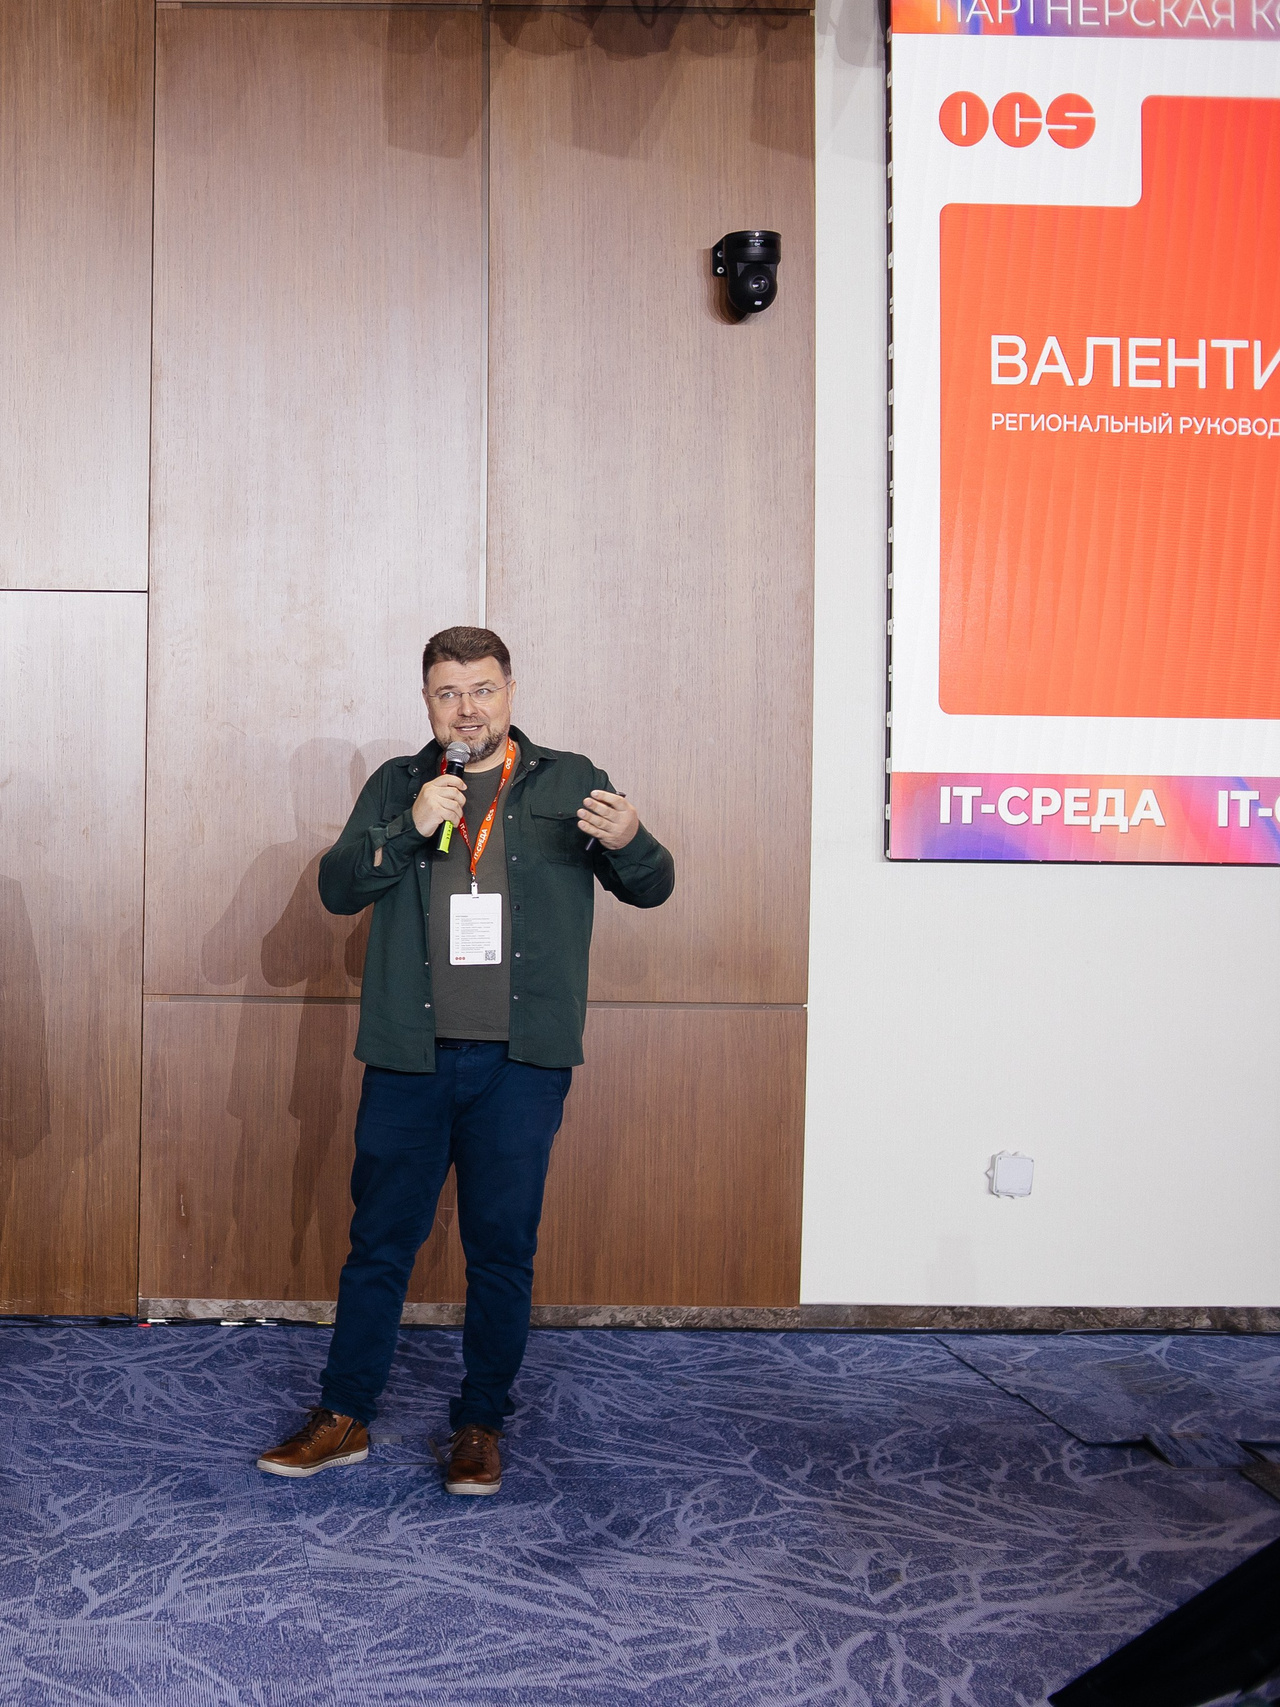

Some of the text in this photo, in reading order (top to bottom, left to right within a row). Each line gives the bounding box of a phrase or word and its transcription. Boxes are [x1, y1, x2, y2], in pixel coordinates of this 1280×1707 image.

[1252, 0, 1280, 31] К
[938, 90, 1096, 149] OCS
[991, 334, 1280, 390] ВАЛЕНТИ
[991, 412, 1173, 434] РЕГИОНАЛЬНЫЙ
[939, 785, 1166, 833] IT-СРЕДА
[1218, 790, 1280, 828] IT-
